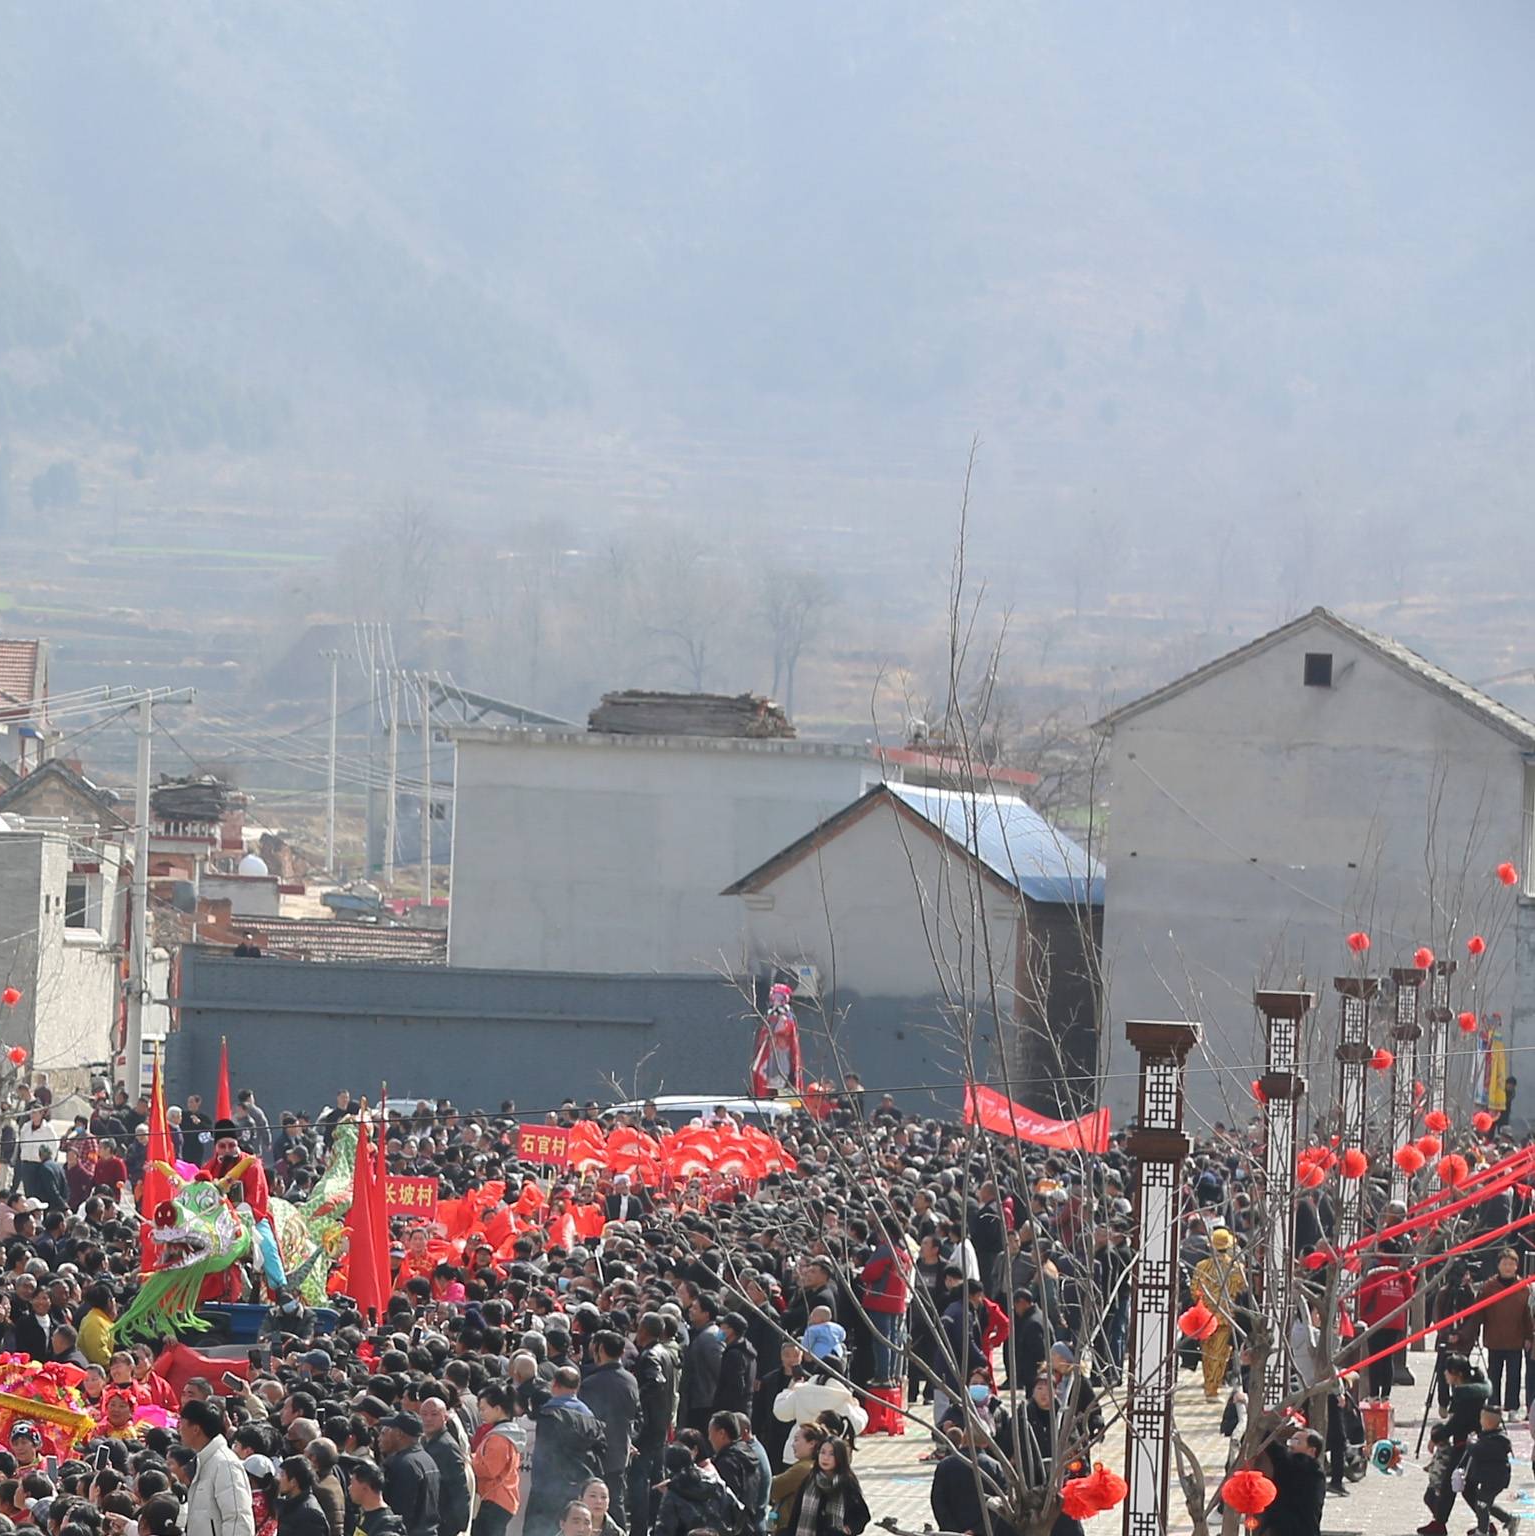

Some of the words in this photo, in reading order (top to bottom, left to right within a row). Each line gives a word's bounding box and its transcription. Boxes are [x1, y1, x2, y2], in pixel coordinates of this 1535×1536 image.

[521, 1134, 567, 1157] 石官村
[385, 1182, 433, 1207] 长坡村
